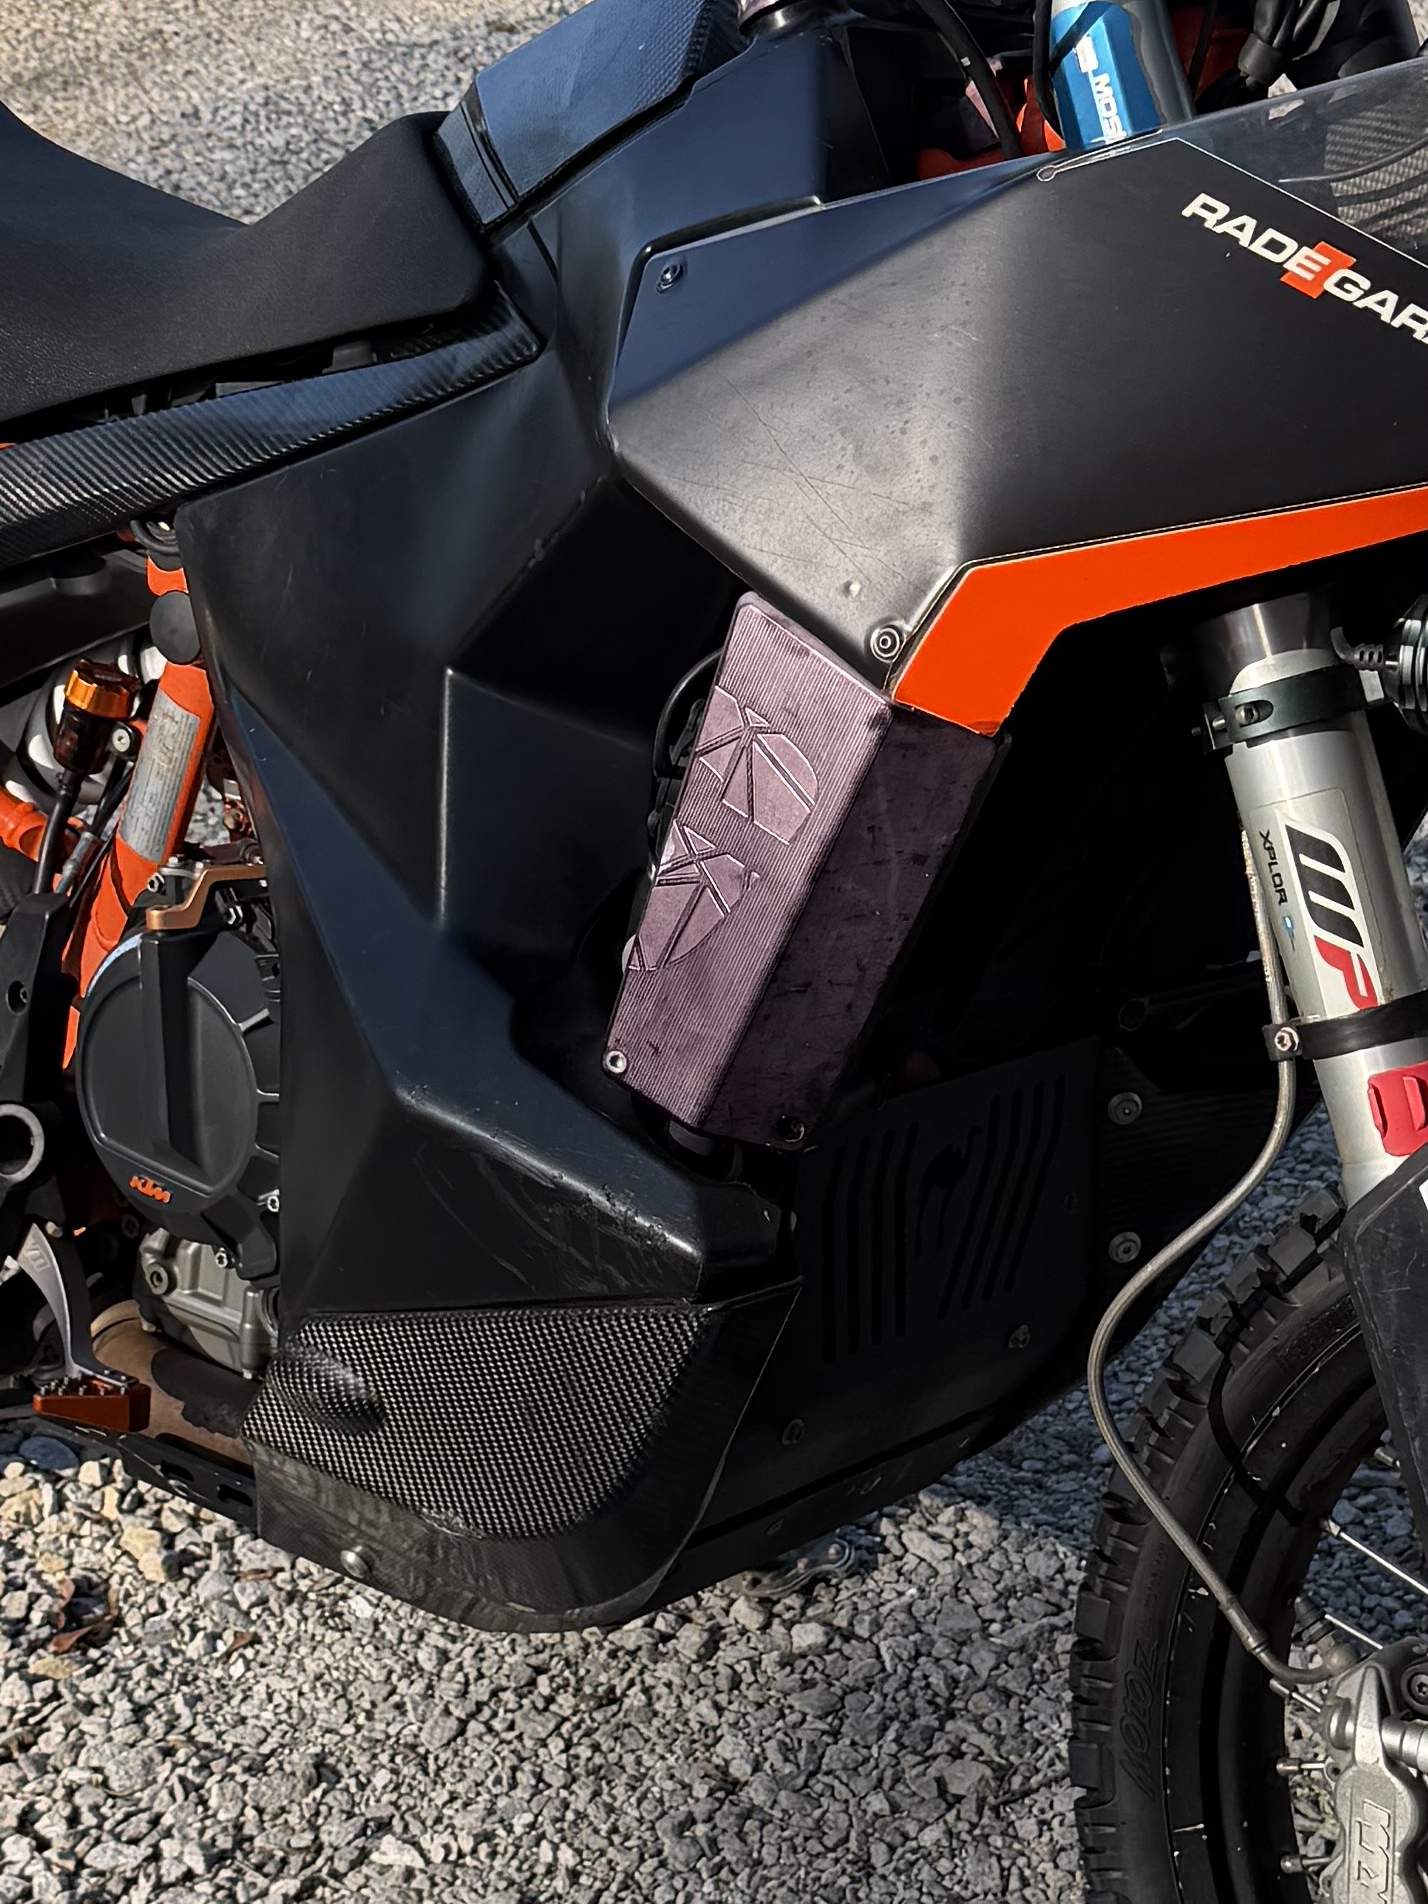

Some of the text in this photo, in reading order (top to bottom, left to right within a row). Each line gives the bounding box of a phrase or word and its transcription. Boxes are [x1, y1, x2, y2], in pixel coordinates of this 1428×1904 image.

[1181, 192, 1332, 282] RADE
[1258, 829, 1289, 907] XPLOR
[130, 1175, 172, 1203] KTM
